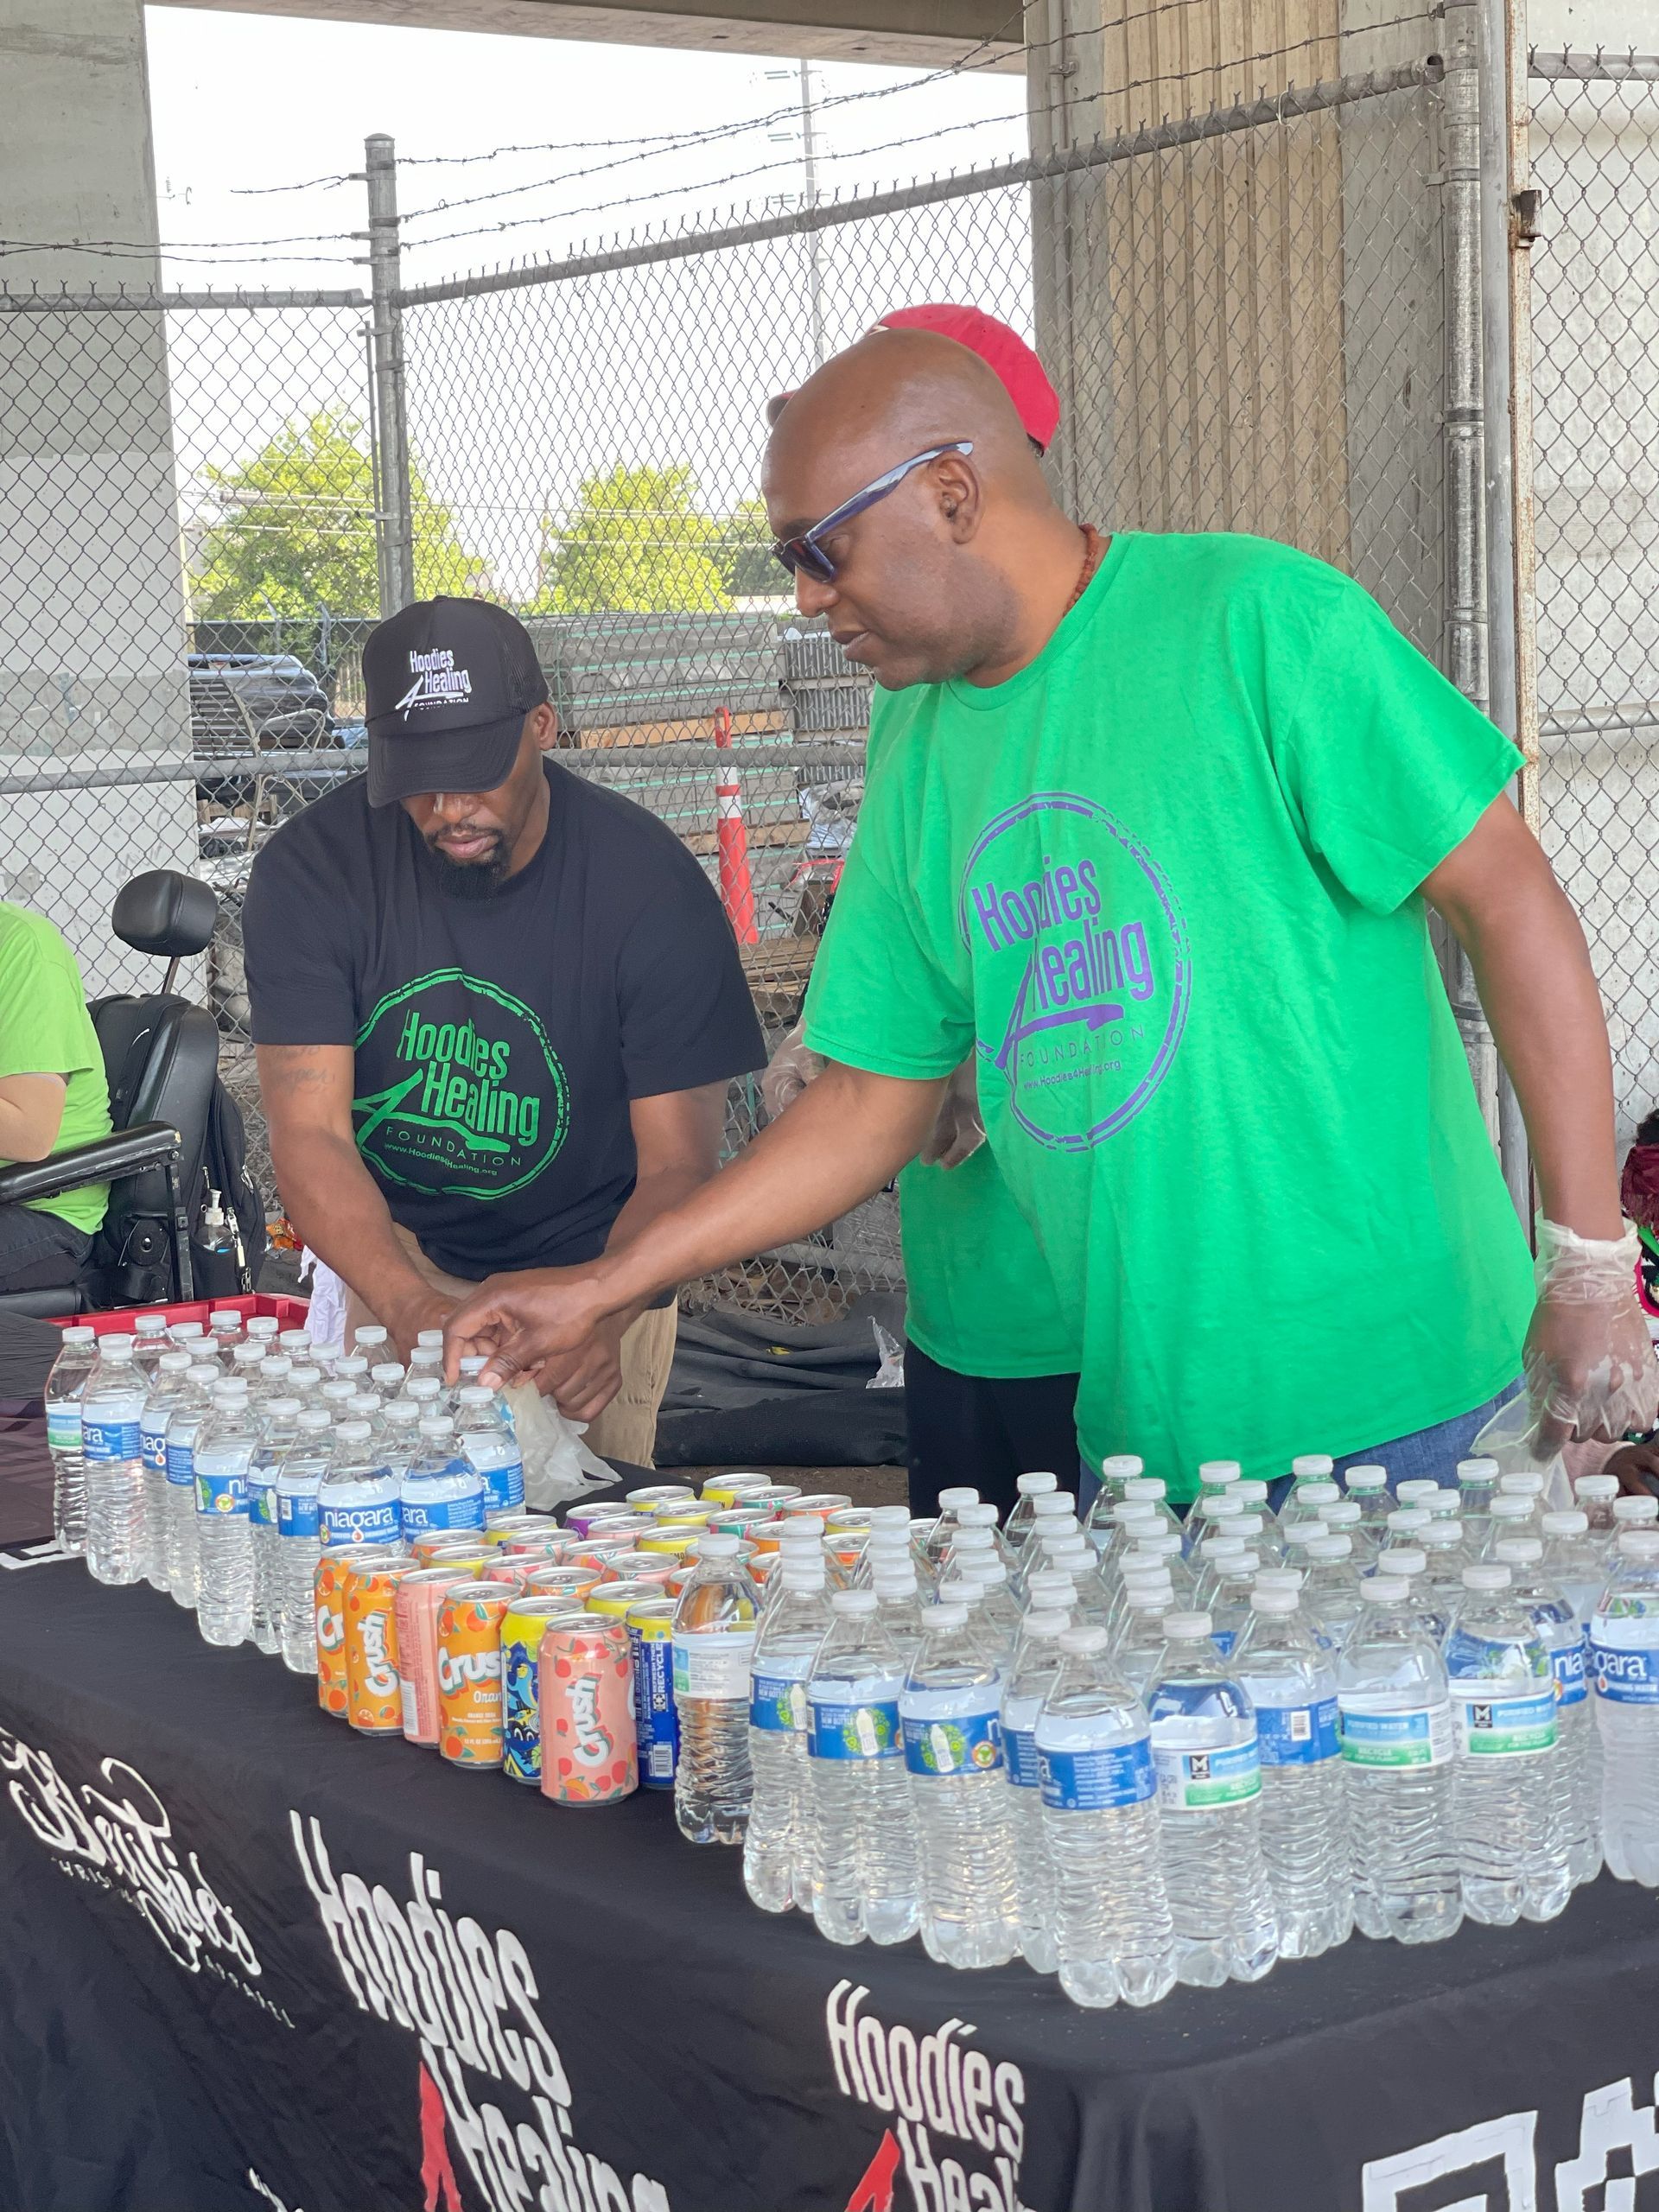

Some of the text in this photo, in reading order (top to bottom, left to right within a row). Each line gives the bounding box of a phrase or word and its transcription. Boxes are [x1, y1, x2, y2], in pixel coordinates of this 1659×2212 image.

[410, 648, 454, 673] Hoodies
[424, 667, 473, 694] Healing
[397, 1009, 510, 1079] Hoodes
[421, 1061, 540, 1147] Healing
[386, 1126, 522, 1166] FOUNDATION
[324, 1506, 394, 1534] niagara
[357, 1613, 398, 1698] Crush
[438, 1647, 501, 1691] Crus
[656, 1643, 665, 1693] RECYCLE
[1595, 1650, 1647, 1678] gara
[565, 1678, 609, 1768] Crush
[290, 1809, 571, 2107] Hoodies
[827, 1979, 1024, 2163] Hoodies
